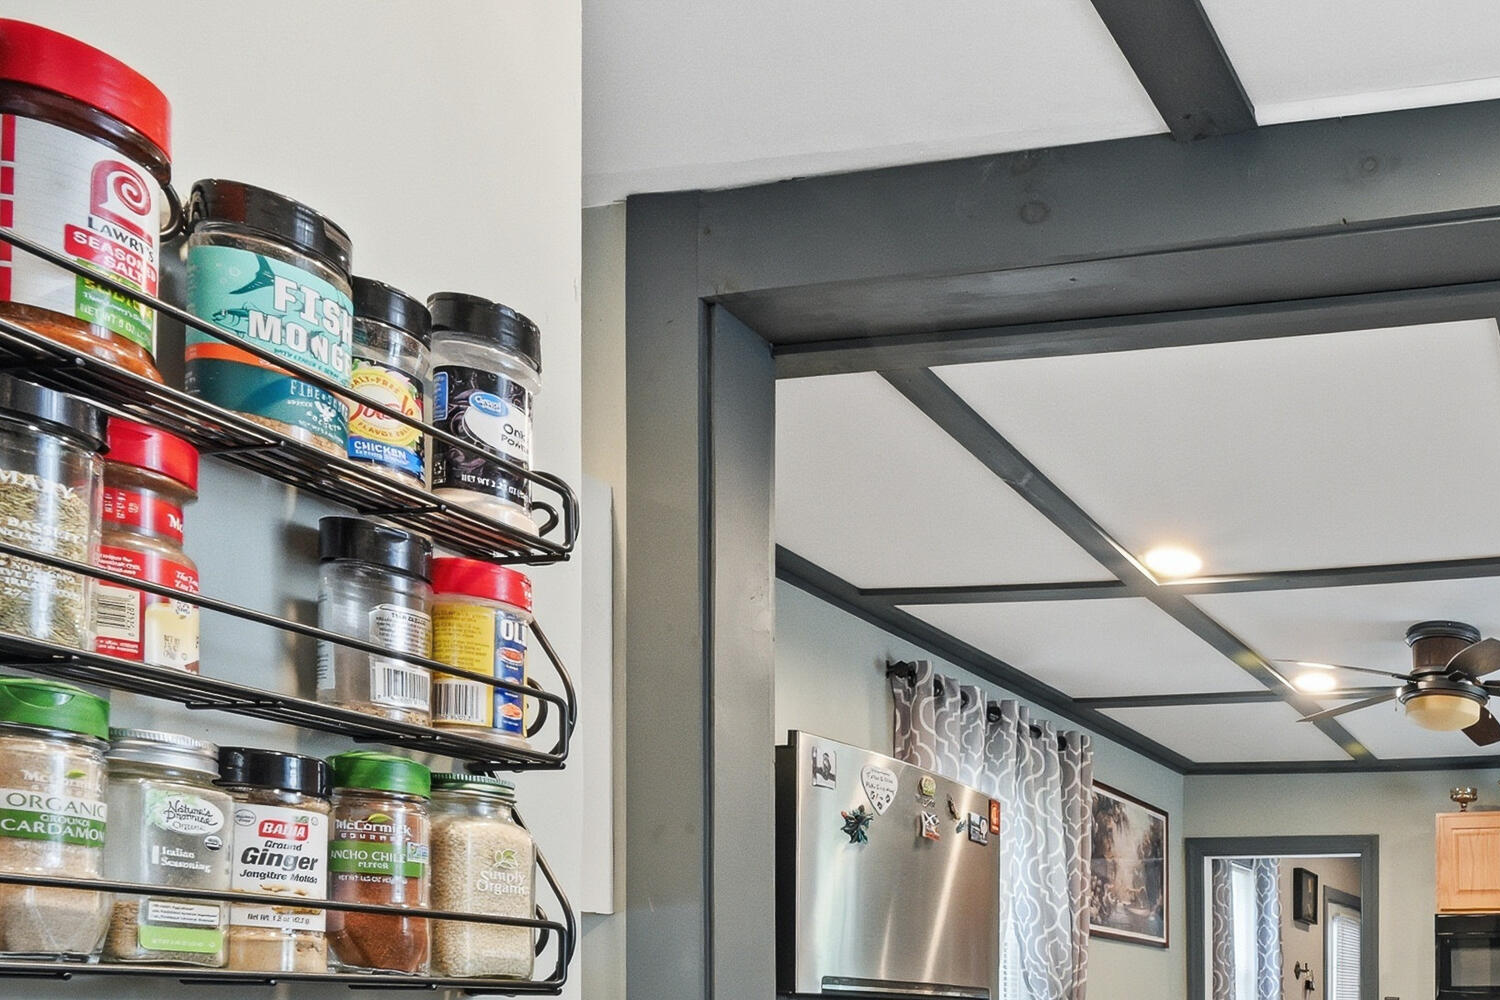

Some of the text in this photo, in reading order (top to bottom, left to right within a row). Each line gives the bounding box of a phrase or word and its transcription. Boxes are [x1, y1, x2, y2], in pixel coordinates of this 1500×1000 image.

[273, 275, 353, 350] FISH
[354, 440, 408, 461] CHICKEN
[6, 792, 105, 818] ORGANIC
[241, 847, 318, 872] Ginger
